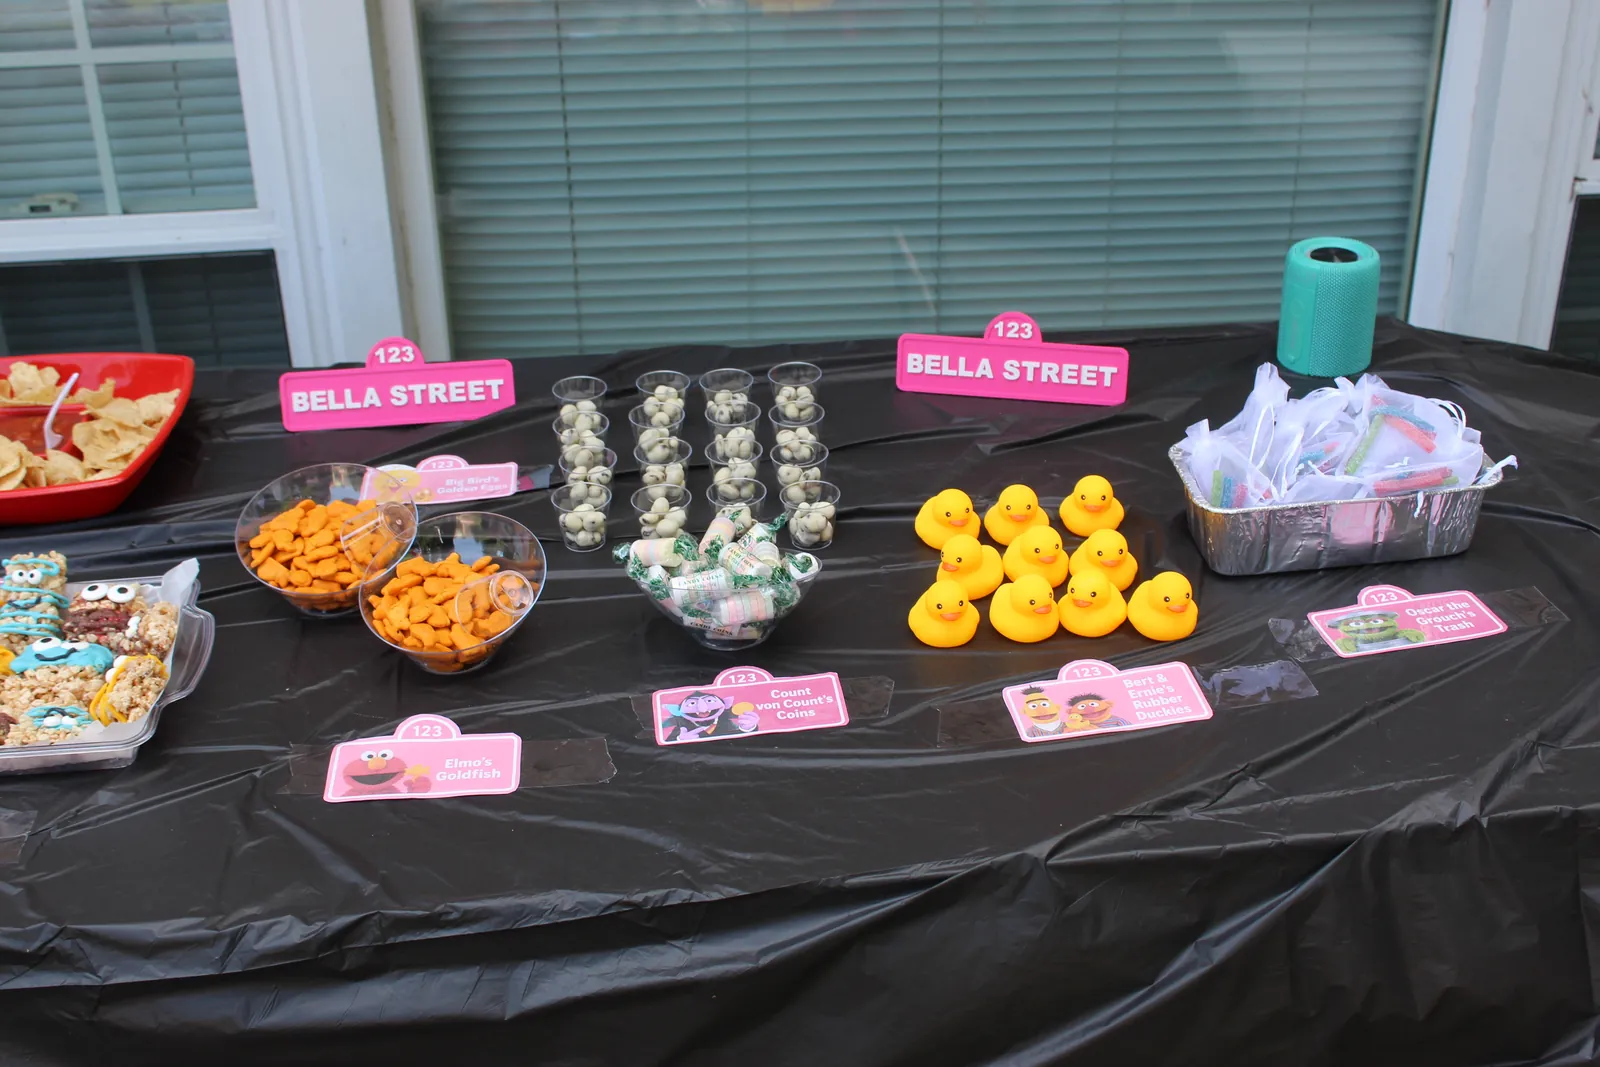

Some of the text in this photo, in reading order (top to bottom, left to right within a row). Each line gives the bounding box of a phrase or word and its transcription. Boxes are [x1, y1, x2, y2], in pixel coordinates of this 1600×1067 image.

[994, 321, 1033, 339] 123
[374, 346, 415, 363] 123
[907, 352, 1118, 387] BELLA STREET
[291, 379, 504, 413] BELLA STREET
[431, 461, 454, 469] 123
[445, 475, 499, 487] Big Bird's
[437, 485, 478, 494] Golden
[1370, 591, 1398, 604] 123
[1405, 601, 1470, 617] Oscar the
[1415, 610, 1476, 626] Grouch's
[690, 621, 711, 630] CANDY
[1434, 620, 1475, 633] Trash
[728, 673, 757, 684] 123
[1073, 667, 1102, 679] 123
[1122, 673, 1168, 689] Bert &
[770, 687, 811, 699] Count
[1128, 684, 1175, 699] Ernie's
[756, 695, 833, 711] von Count's
[1132, 695, 1183, 710] Rubber
[776, 709, 816, 720] Coins
[1135, 704, 1193, 721] Duckies
[413, 725, 443, 737] 123
[445, 757, 492, 768] Elmo's
[436, 769, 501, 781] Goldfish
